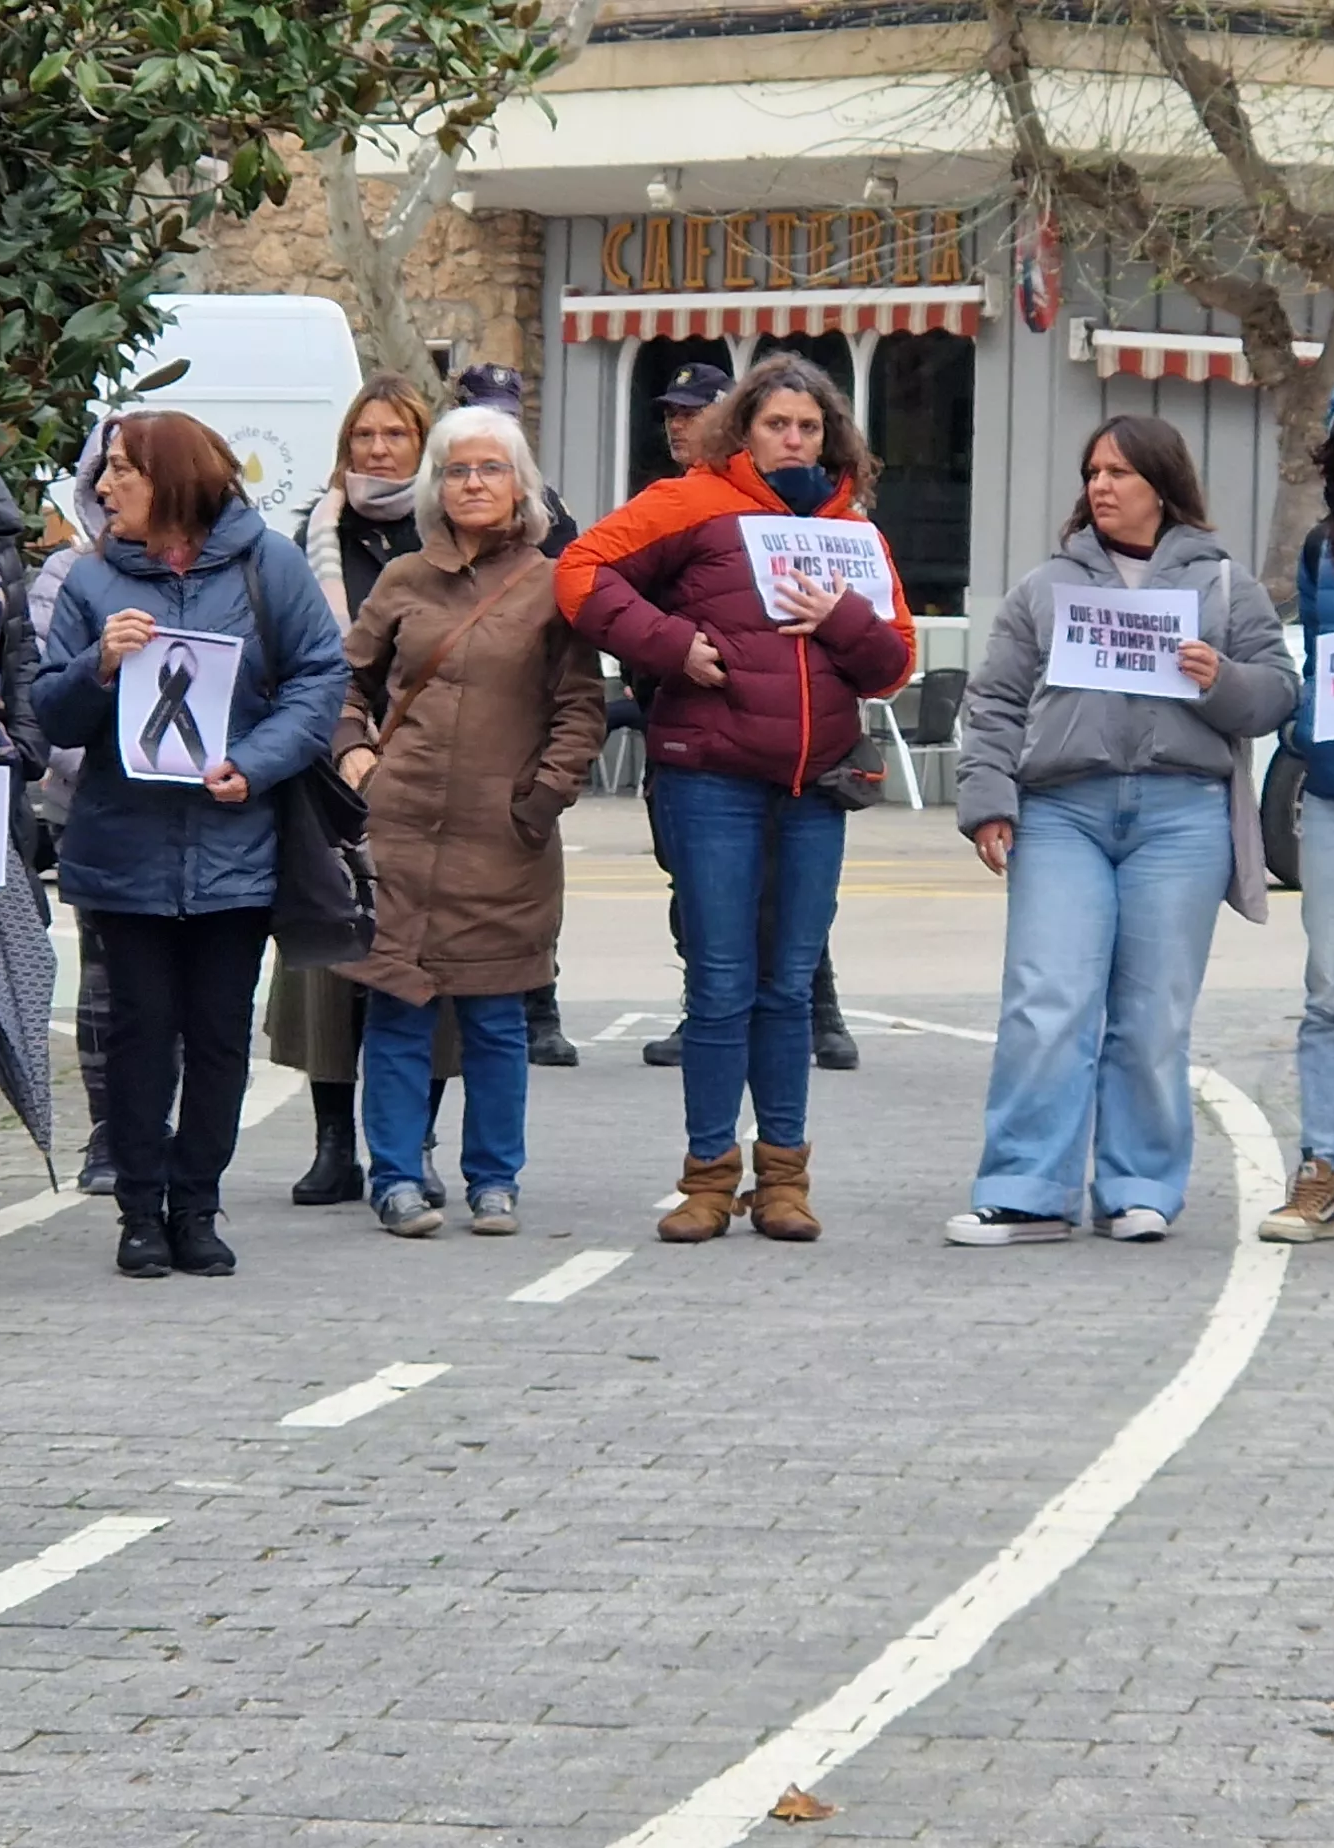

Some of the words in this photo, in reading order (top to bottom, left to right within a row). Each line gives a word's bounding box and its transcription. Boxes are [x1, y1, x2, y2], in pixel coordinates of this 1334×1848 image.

[601, 209, 964, 291] CAFETERIA
[227, 426, 260, 444] ceite
[262, 428, 280, 445] de
[278, 440, 294, 464] los
[761, 534, 789, 552] QUE
[795, 534, 813, 552] EL
[815, 534, 875, 558] TRABAJO
[770, 556, 787, 576] NO
[793, 556, 822, 576] NOS
[827, 558, 880, 579] CUESTE
[1069, 604, 1093, 623] QUE
[1097, 608, 1112, 625] LA
[1117, 612, 1181, 633] VOCACIÓN
[1067, 626, 1083, 644] NO
[1089, 627, 1105, 646] SE
[1110, 630, 1155, 650] ROMPA
[1095, 650, 1107, 668] EL
[1115, 652, 1155, 672] MIEDO
